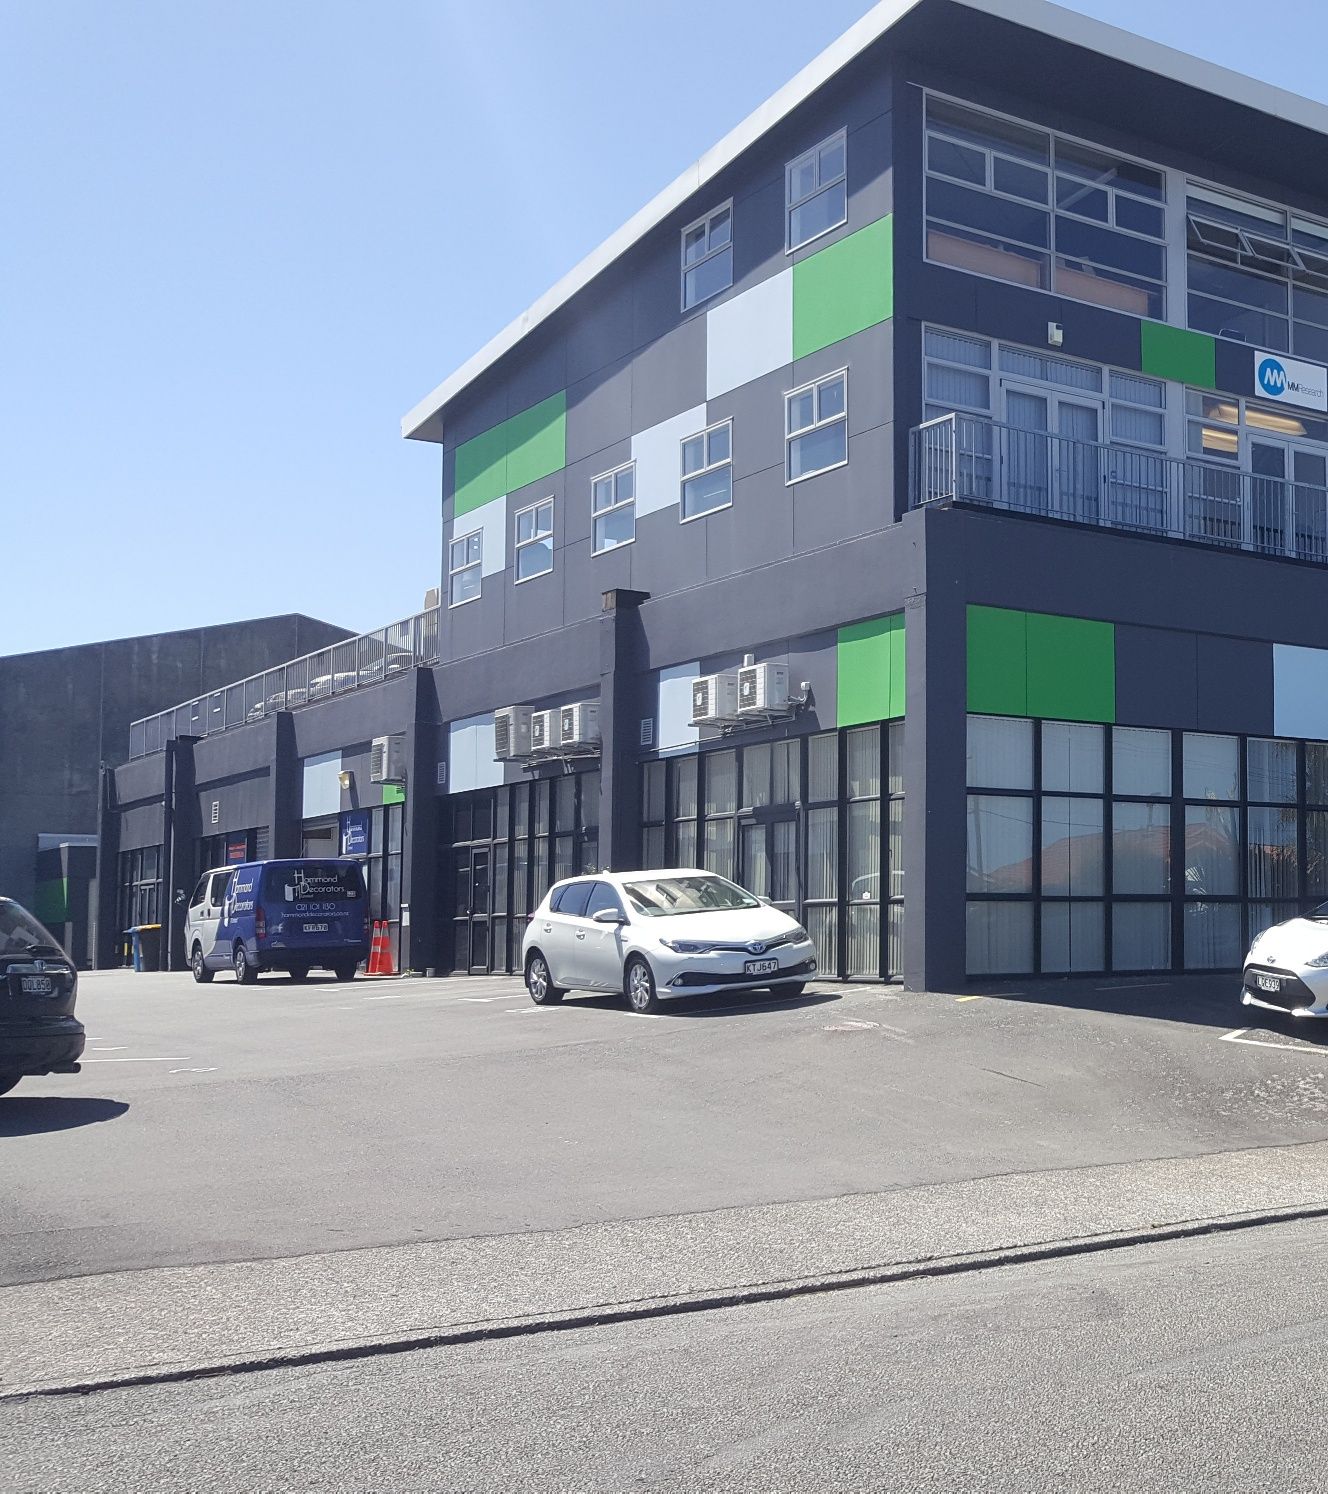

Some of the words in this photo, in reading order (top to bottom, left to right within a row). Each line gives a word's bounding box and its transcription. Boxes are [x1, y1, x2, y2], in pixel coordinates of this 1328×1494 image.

[294, 869, 338, 885] Hammond
[300, 882, 345, 894] Decorators
[745, 961, 777, 974] KTJ647
